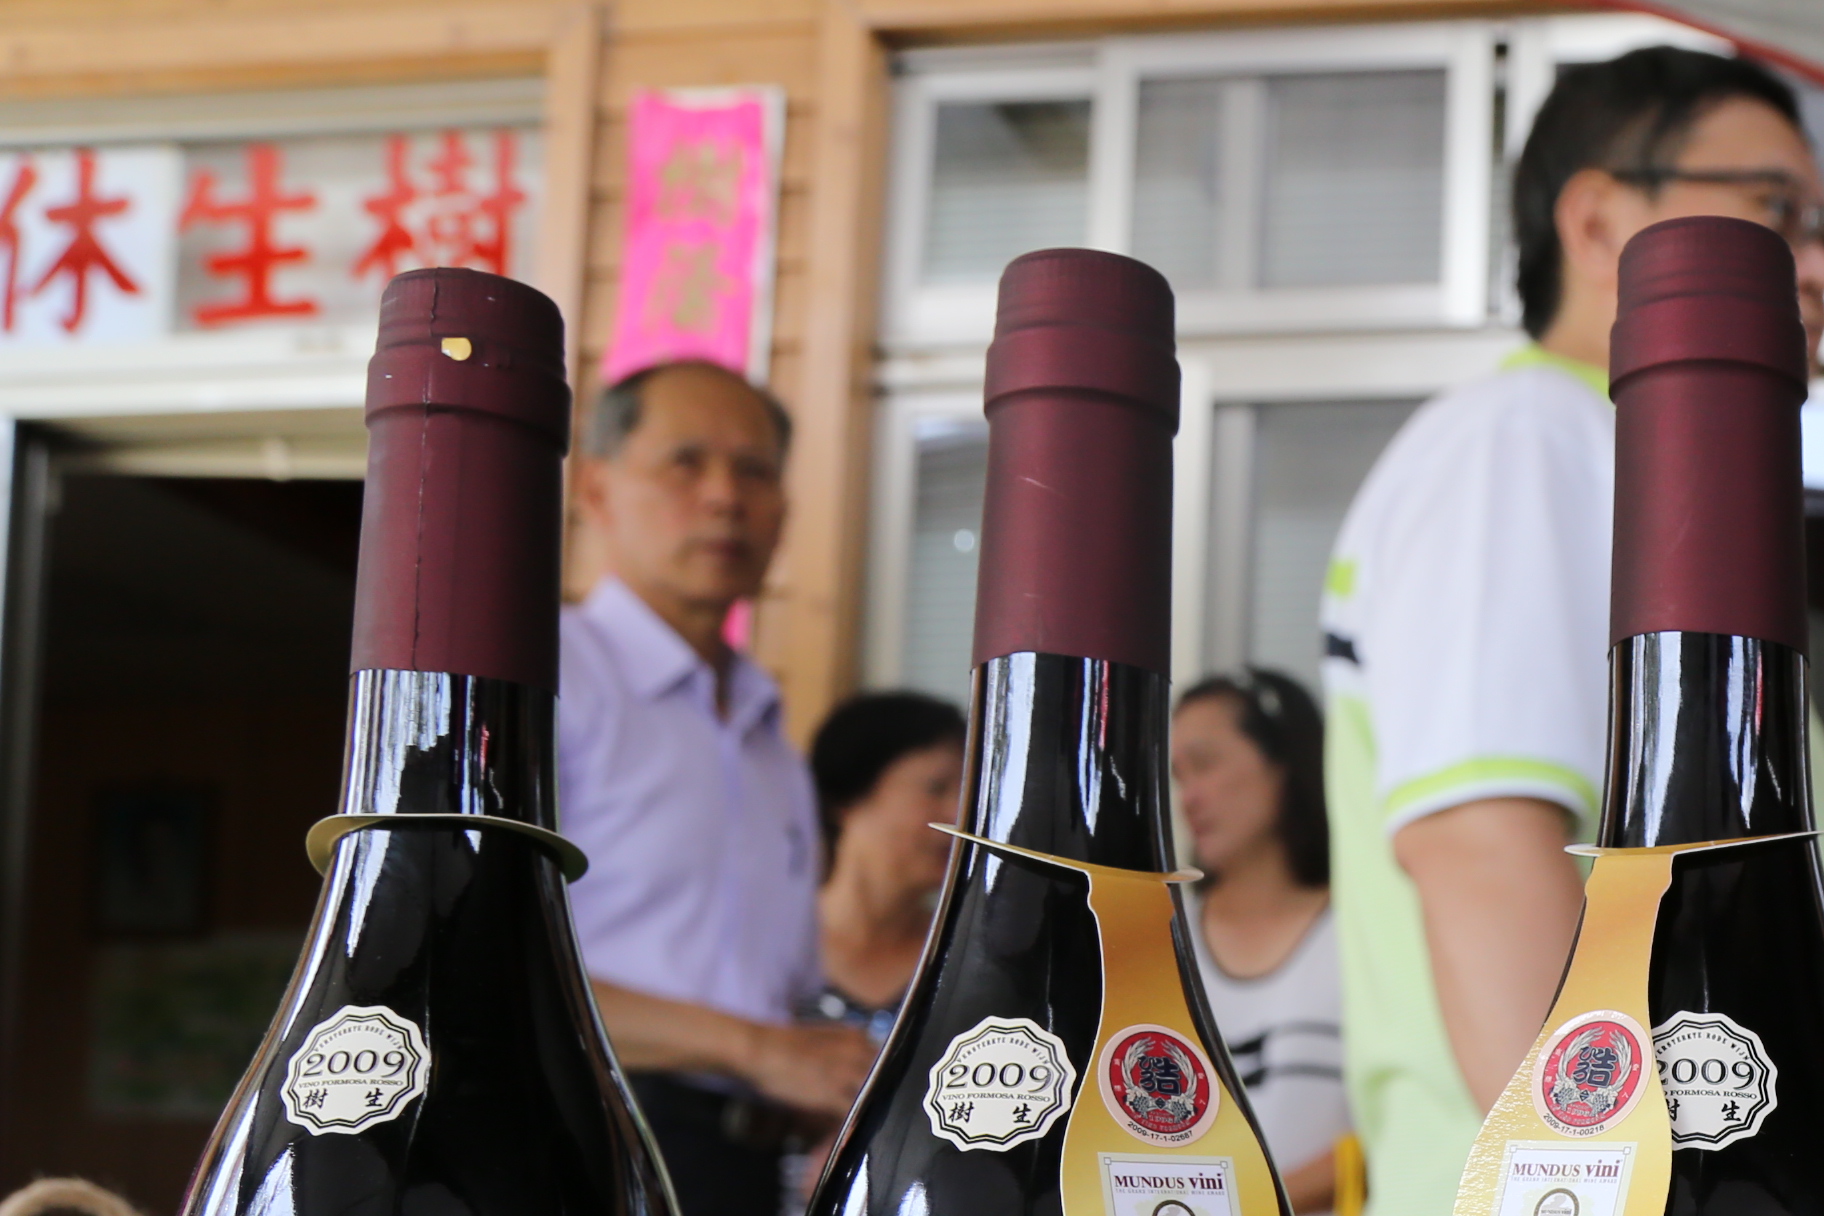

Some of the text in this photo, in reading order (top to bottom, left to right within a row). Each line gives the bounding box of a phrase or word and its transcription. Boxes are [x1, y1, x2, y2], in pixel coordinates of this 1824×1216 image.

[302, 1050, 408, 1078] 2009
[945, 1063, 1054, 1093] 2009
[1512, 1159, 1620, 1178] MUNDUS vini
[1114, 1173, 1223, 1189] MUNDUS vini
